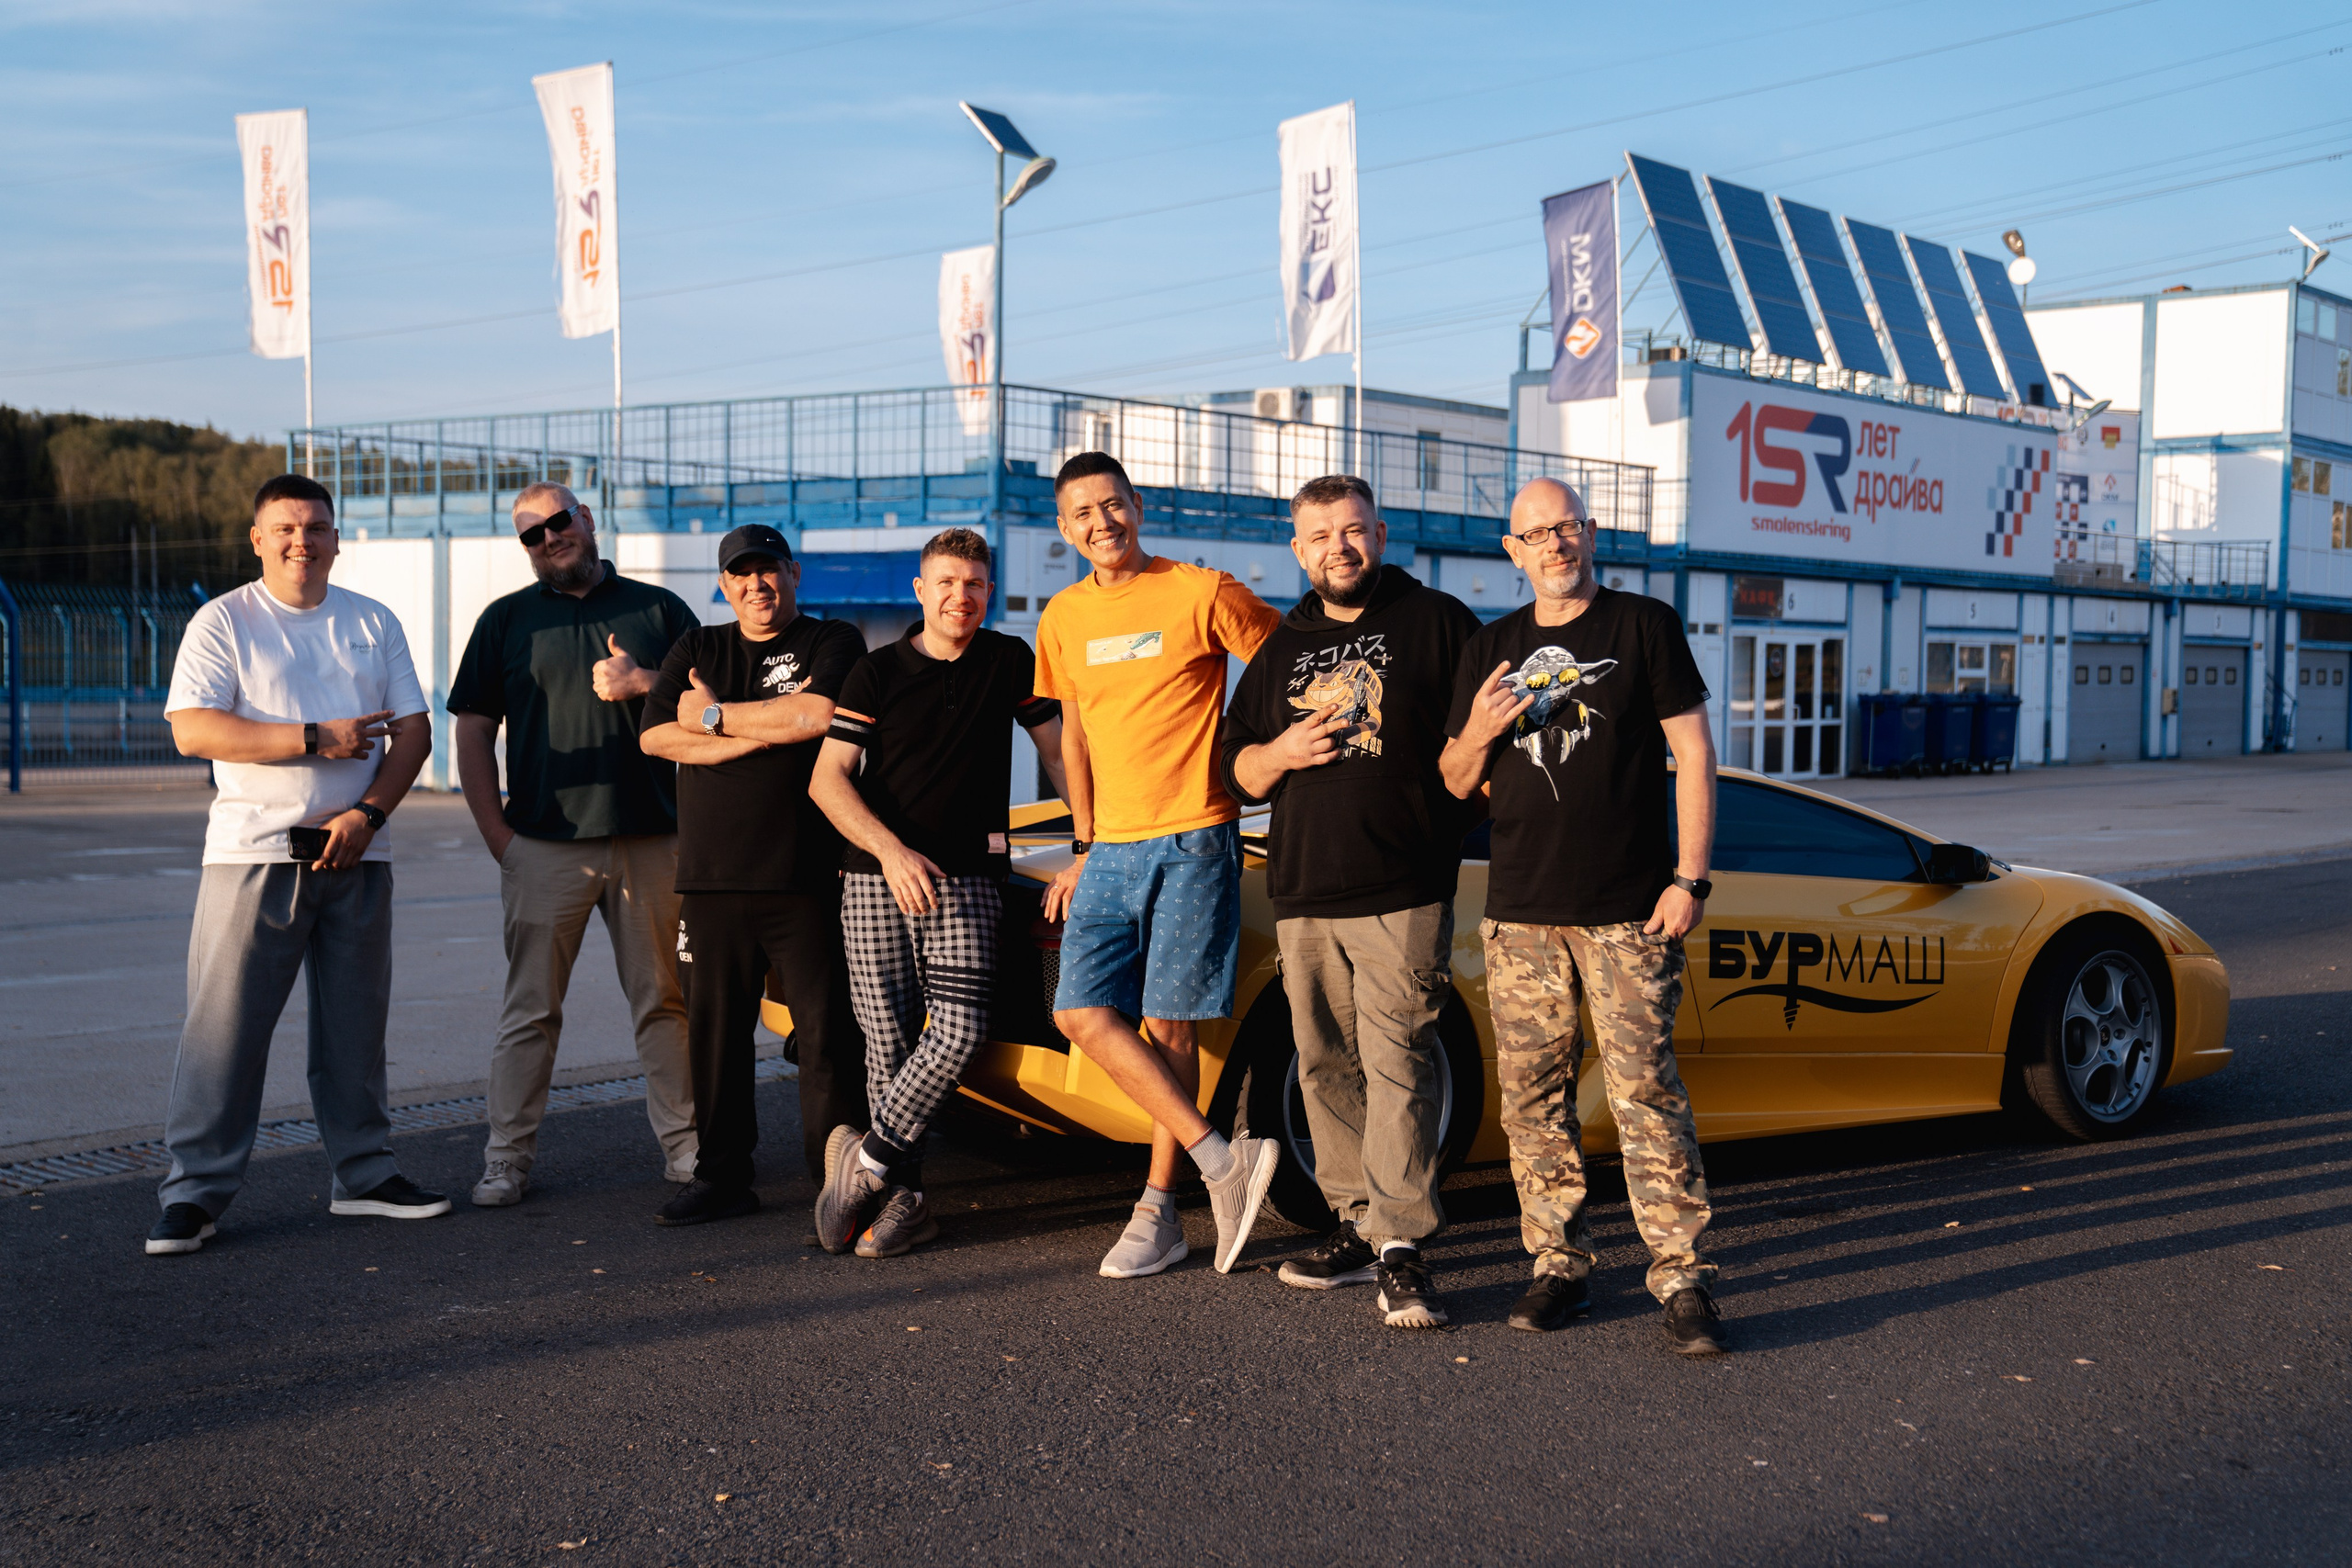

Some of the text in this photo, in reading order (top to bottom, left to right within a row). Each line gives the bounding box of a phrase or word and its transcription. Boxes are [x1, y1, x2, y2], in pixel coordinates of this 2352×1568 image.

[1856, 420, 1901, 460] лет
[1854, 457, 1943, 524] драйва
[1751, 516, 1851, 542] smolenskring
[1516, 577, 1524, 597] 7
[1788, 592, 1795, 611] 6
[1971, 602, 1976, 619] 5
[2109, 608, 2115, 625] 4
[763, 653, 795, 666] AUTO
[1292, 634, 1386, 672] ネコバス
[1708, 929, 1944, 988] БУРМАШ
